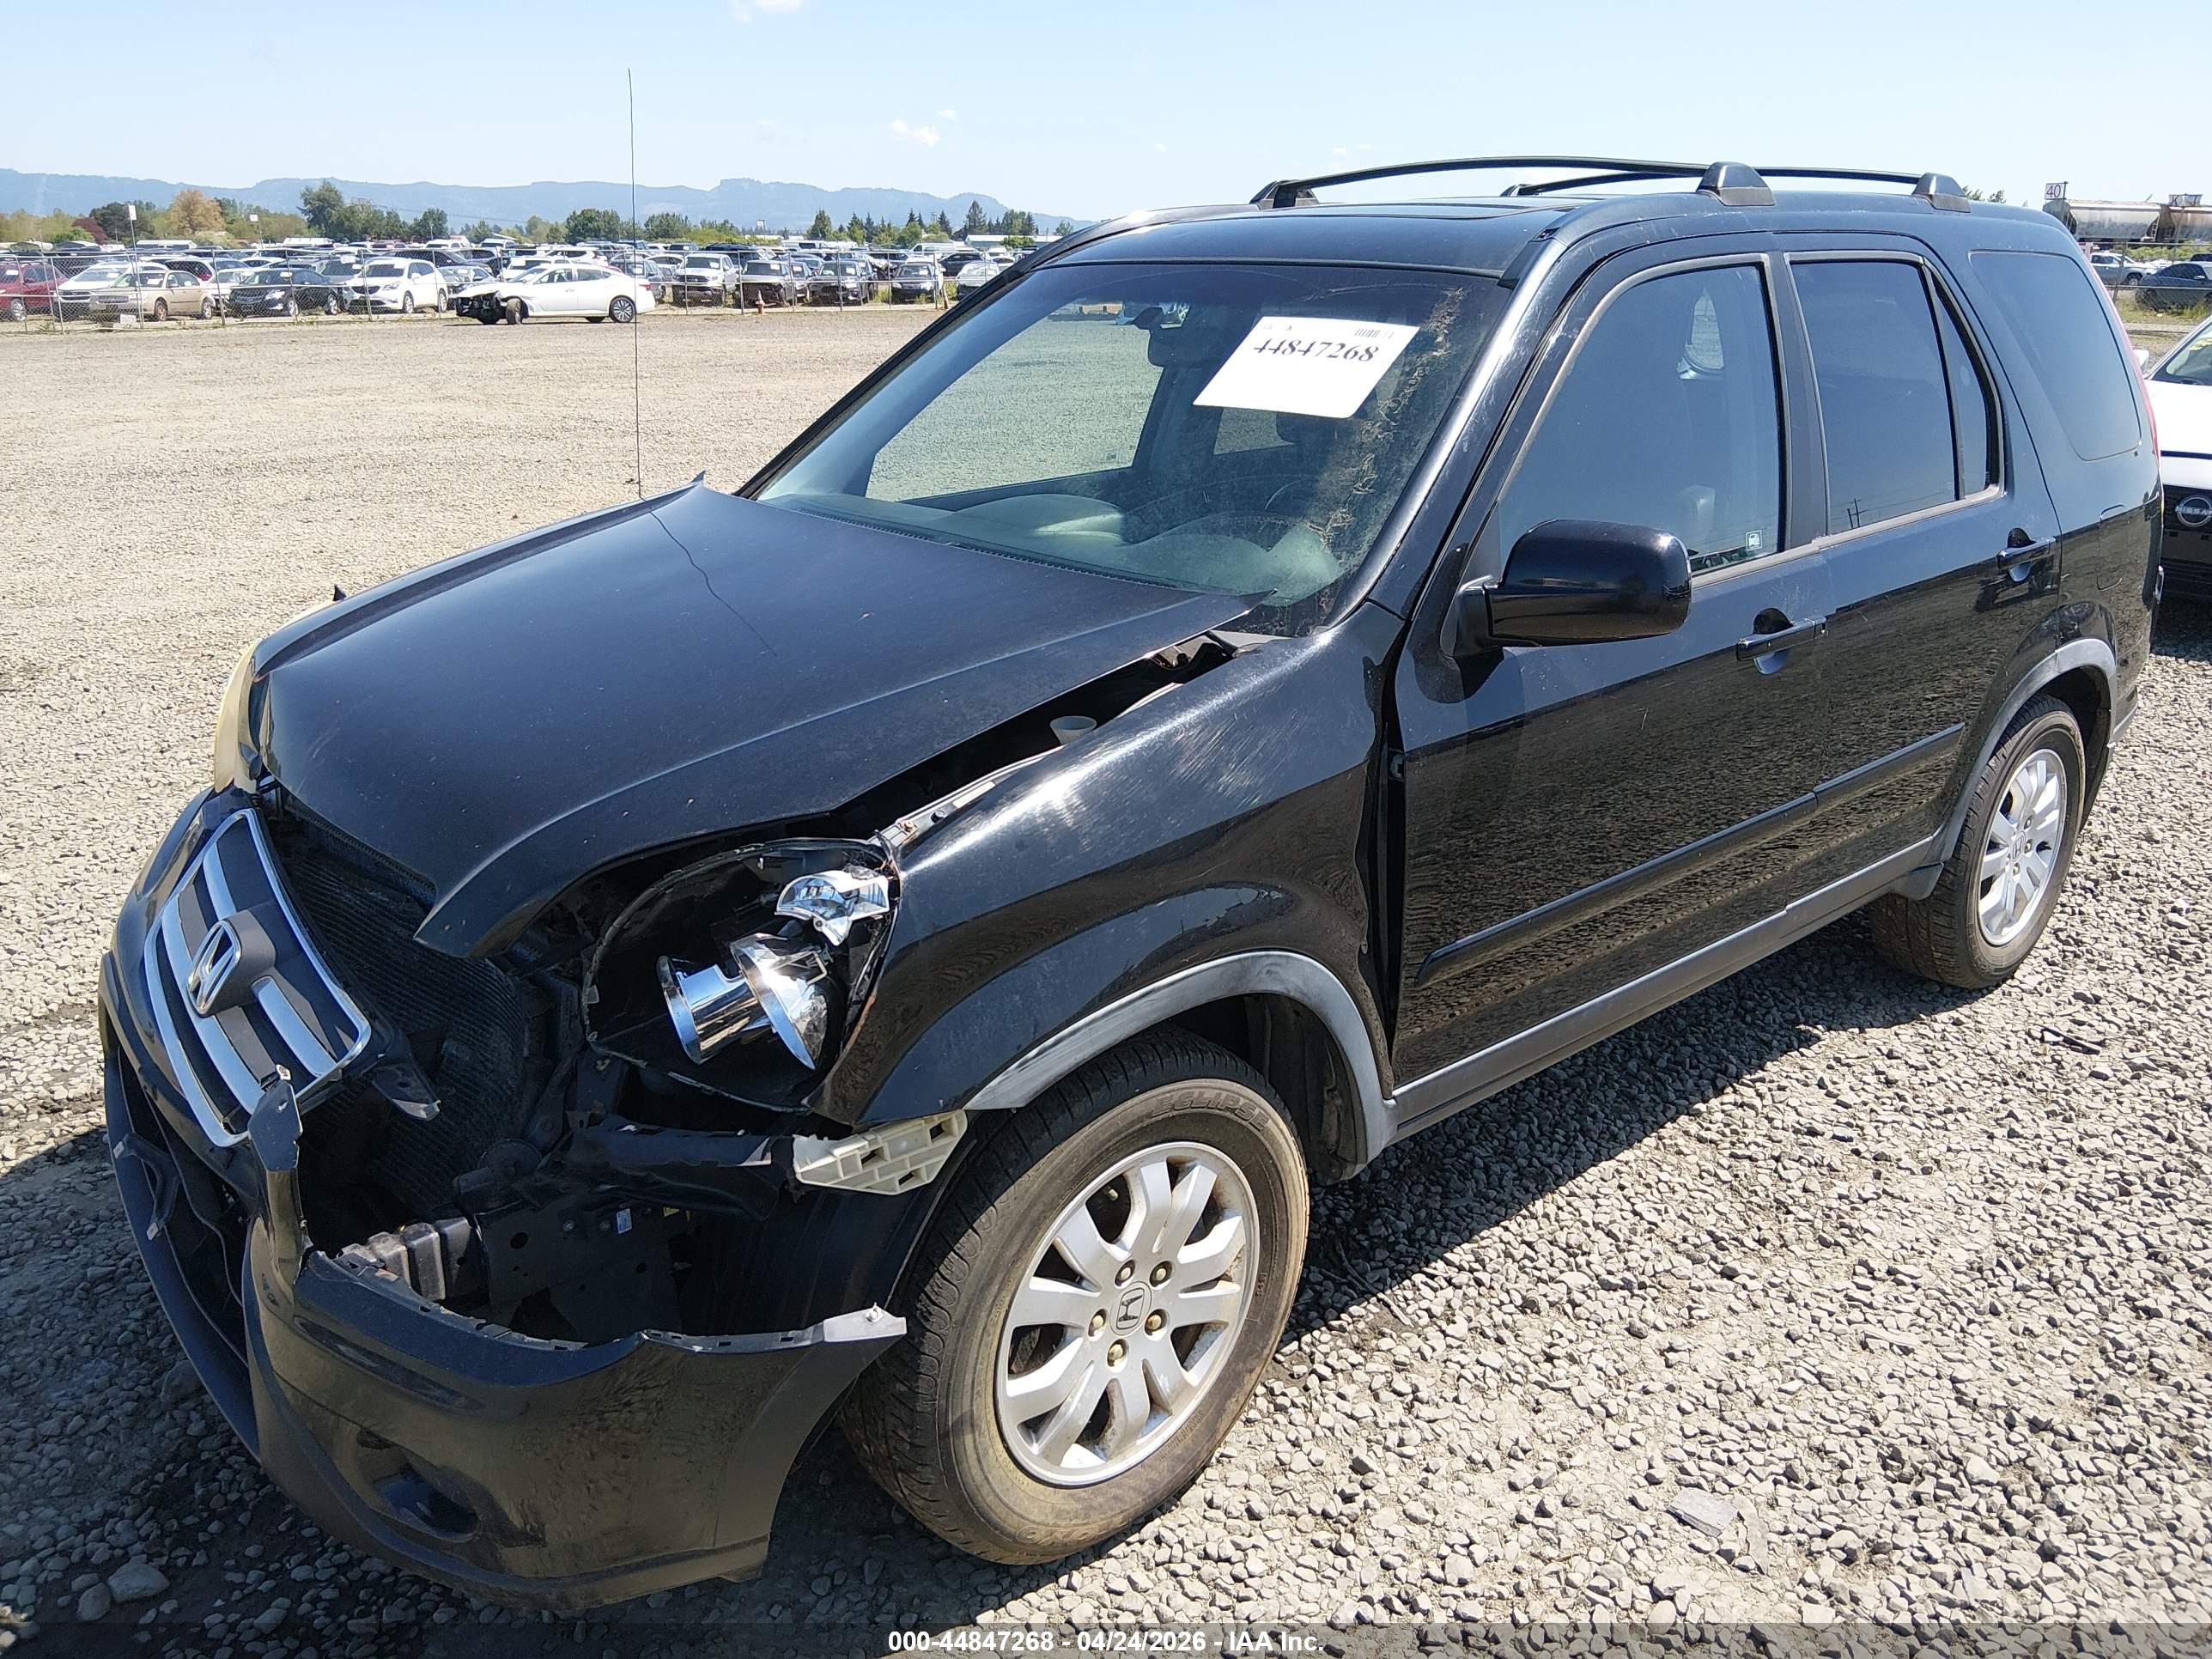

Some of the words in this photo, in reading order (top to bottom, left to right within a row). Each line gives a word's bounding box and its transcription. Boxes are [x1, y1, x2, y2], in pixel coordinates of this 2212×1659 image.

[2046, 184, 2062, 198] 40
[1254, 338, 1378, 362] 44847268
[1149, 1091, 1270, 1132] ECLIPSE
